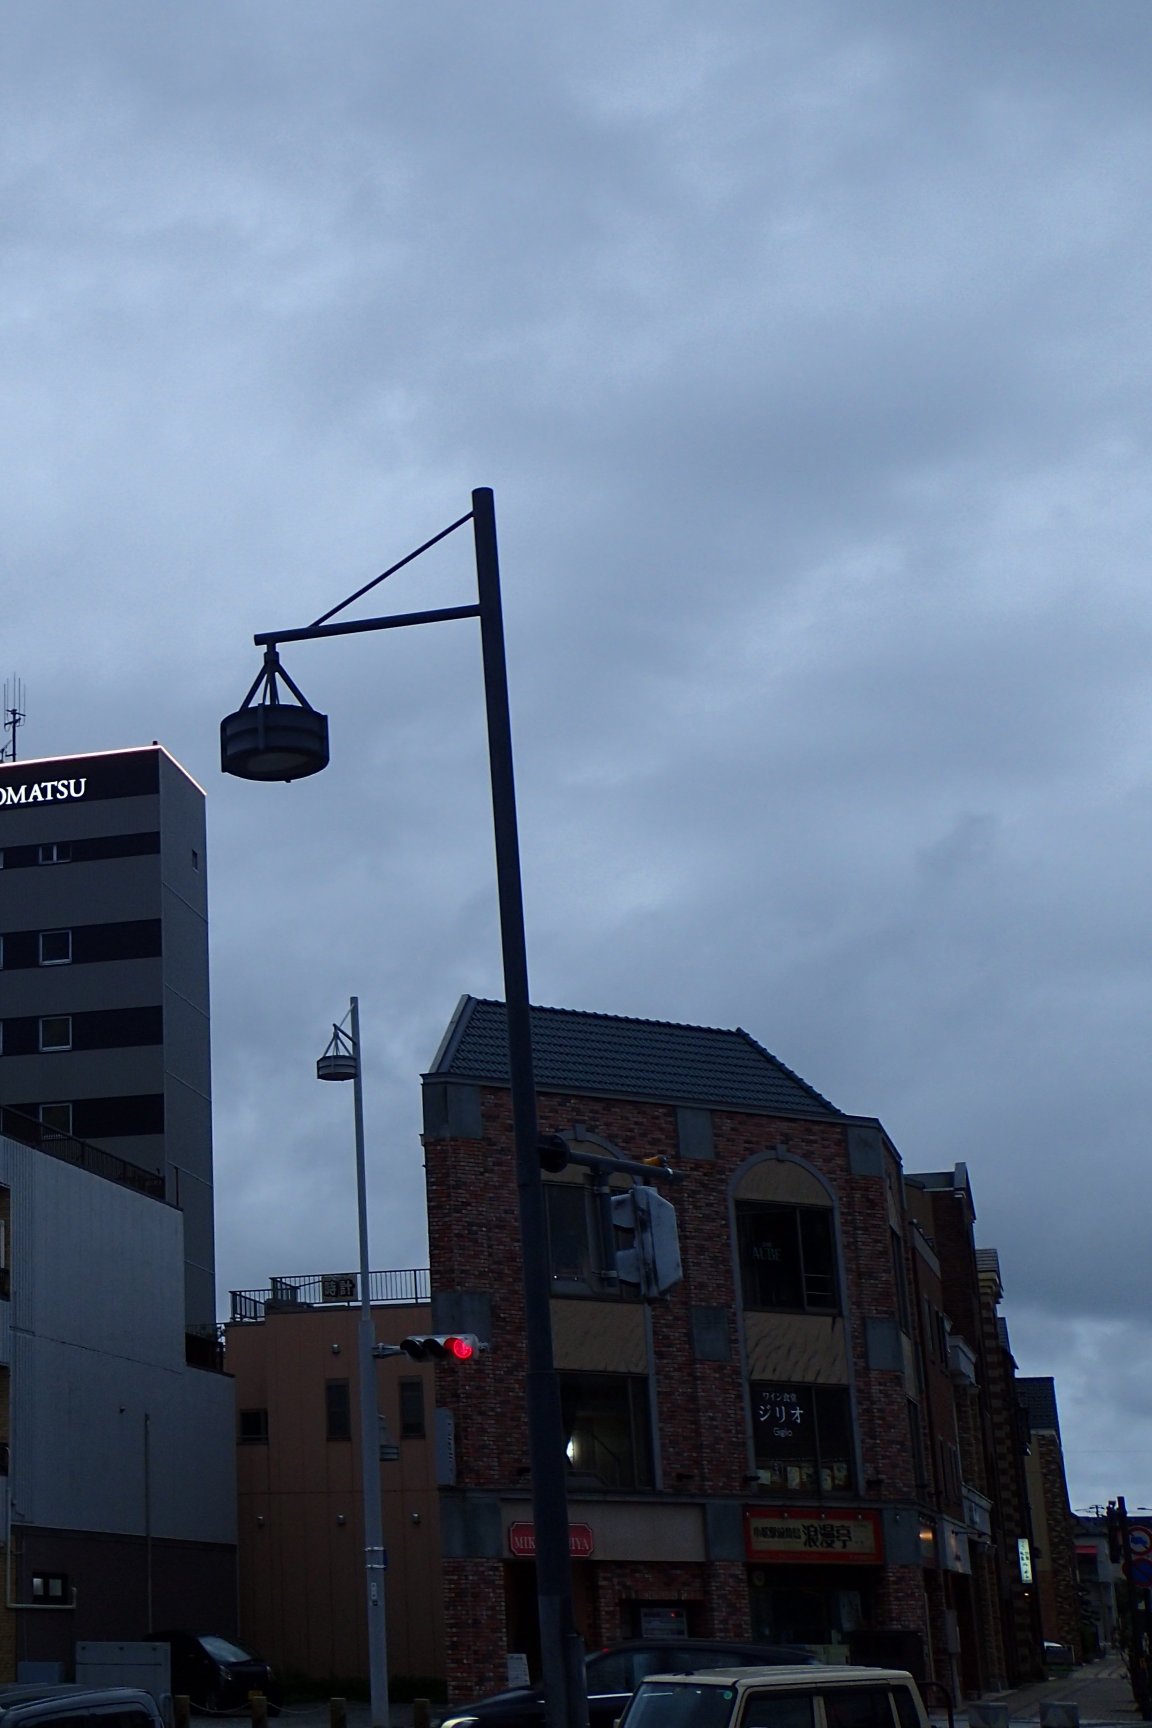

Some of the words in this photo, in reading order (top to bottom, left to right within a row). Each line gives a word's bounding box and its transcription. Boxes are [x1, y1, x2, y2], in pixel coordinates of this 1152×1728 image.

[324, 1279, 355, 1297] 時計
[759, 1404, 804, 1424] ジリオ
[801, 1524, 852, 1549] 浪漫亭
